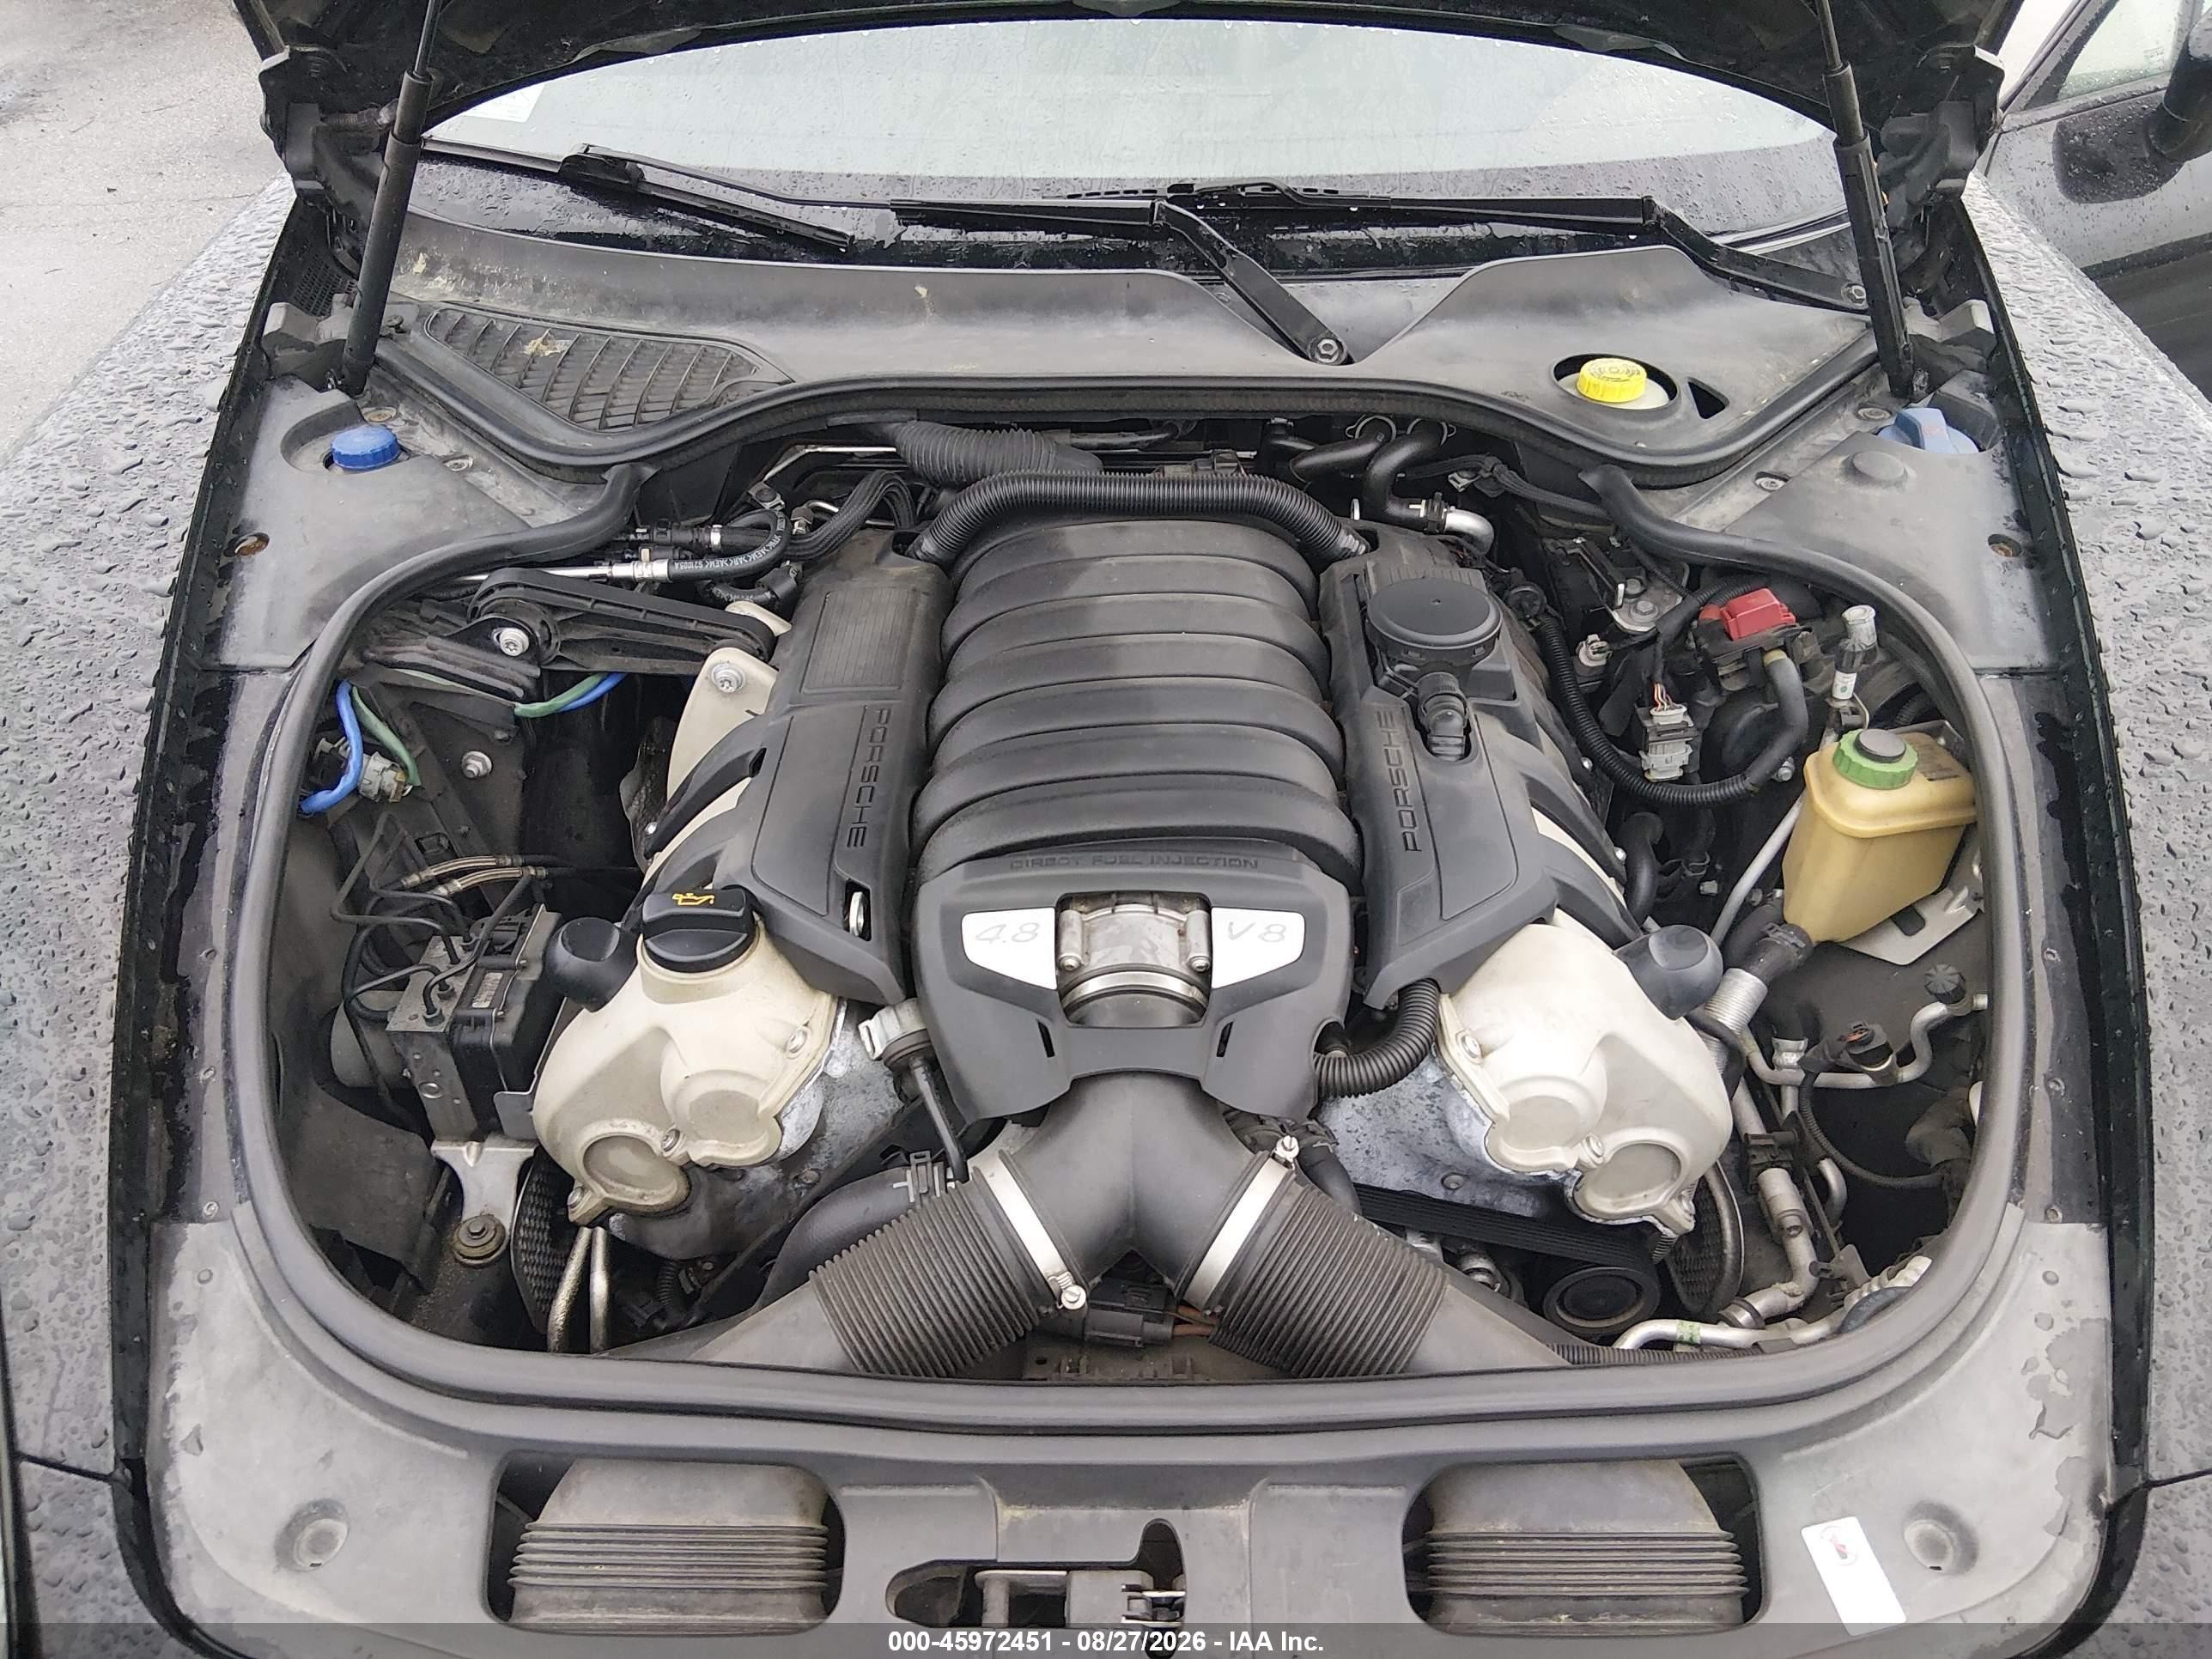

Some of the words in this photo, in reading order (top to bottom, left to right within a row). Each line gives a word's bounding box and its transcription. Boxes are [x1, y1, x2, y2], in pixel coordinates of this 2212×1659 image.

[847, 708, 891, 848] PORSCHE
[1376, 711, 1423, 853] PORSCHE
[1010, 856, 1079, 870] DIRECT
[1091, 854, 1142, 866] FUEL
[1150, 854, 1259, 870] INJECTION
